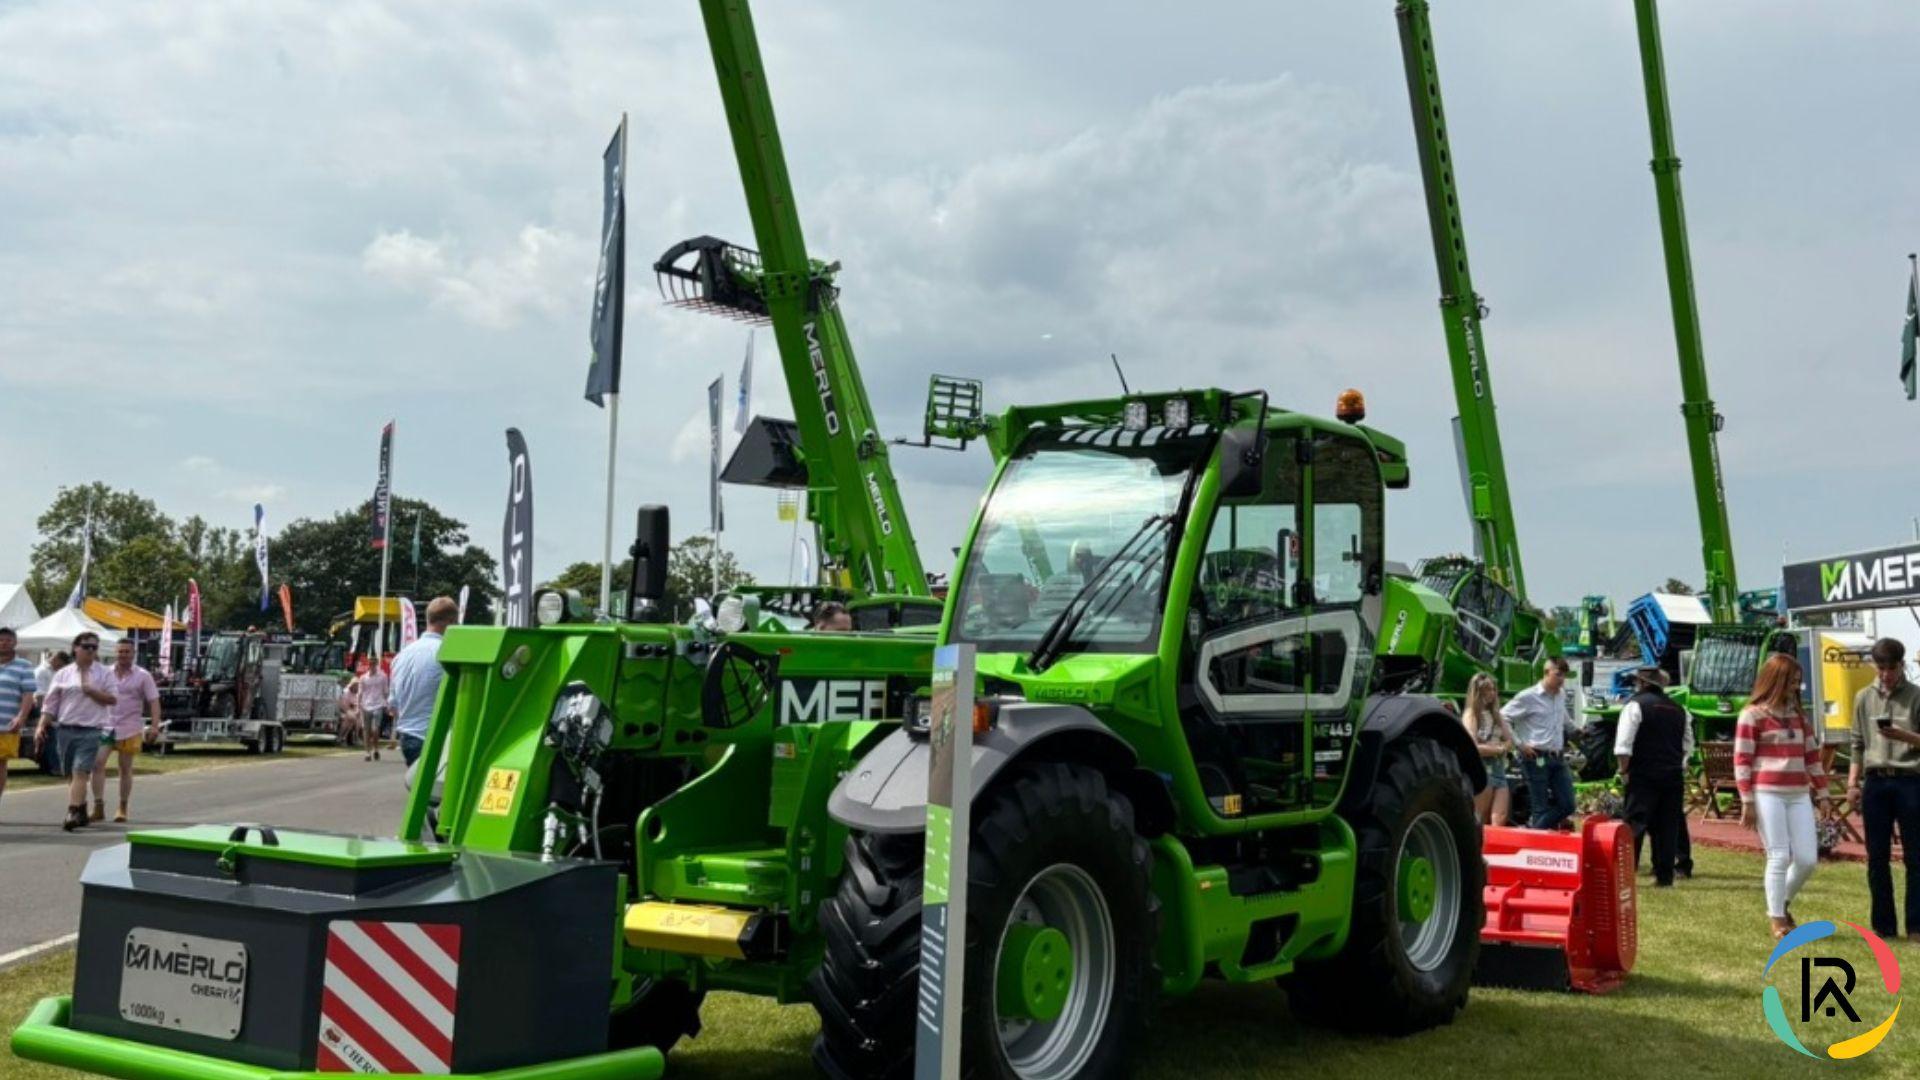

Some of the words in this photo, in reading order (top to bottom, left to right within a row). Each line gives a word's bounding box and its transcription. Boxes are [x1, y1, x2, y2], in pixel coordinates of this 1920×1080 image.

[803, 322, 839, 435] MERLO
[866, 471, 892, 535] MERLO
[1526, 855, 1575, 869] BISONTE
[152, 948, 245, 984] MERLO
[130, 1003, 165, 1024] 1000kg
